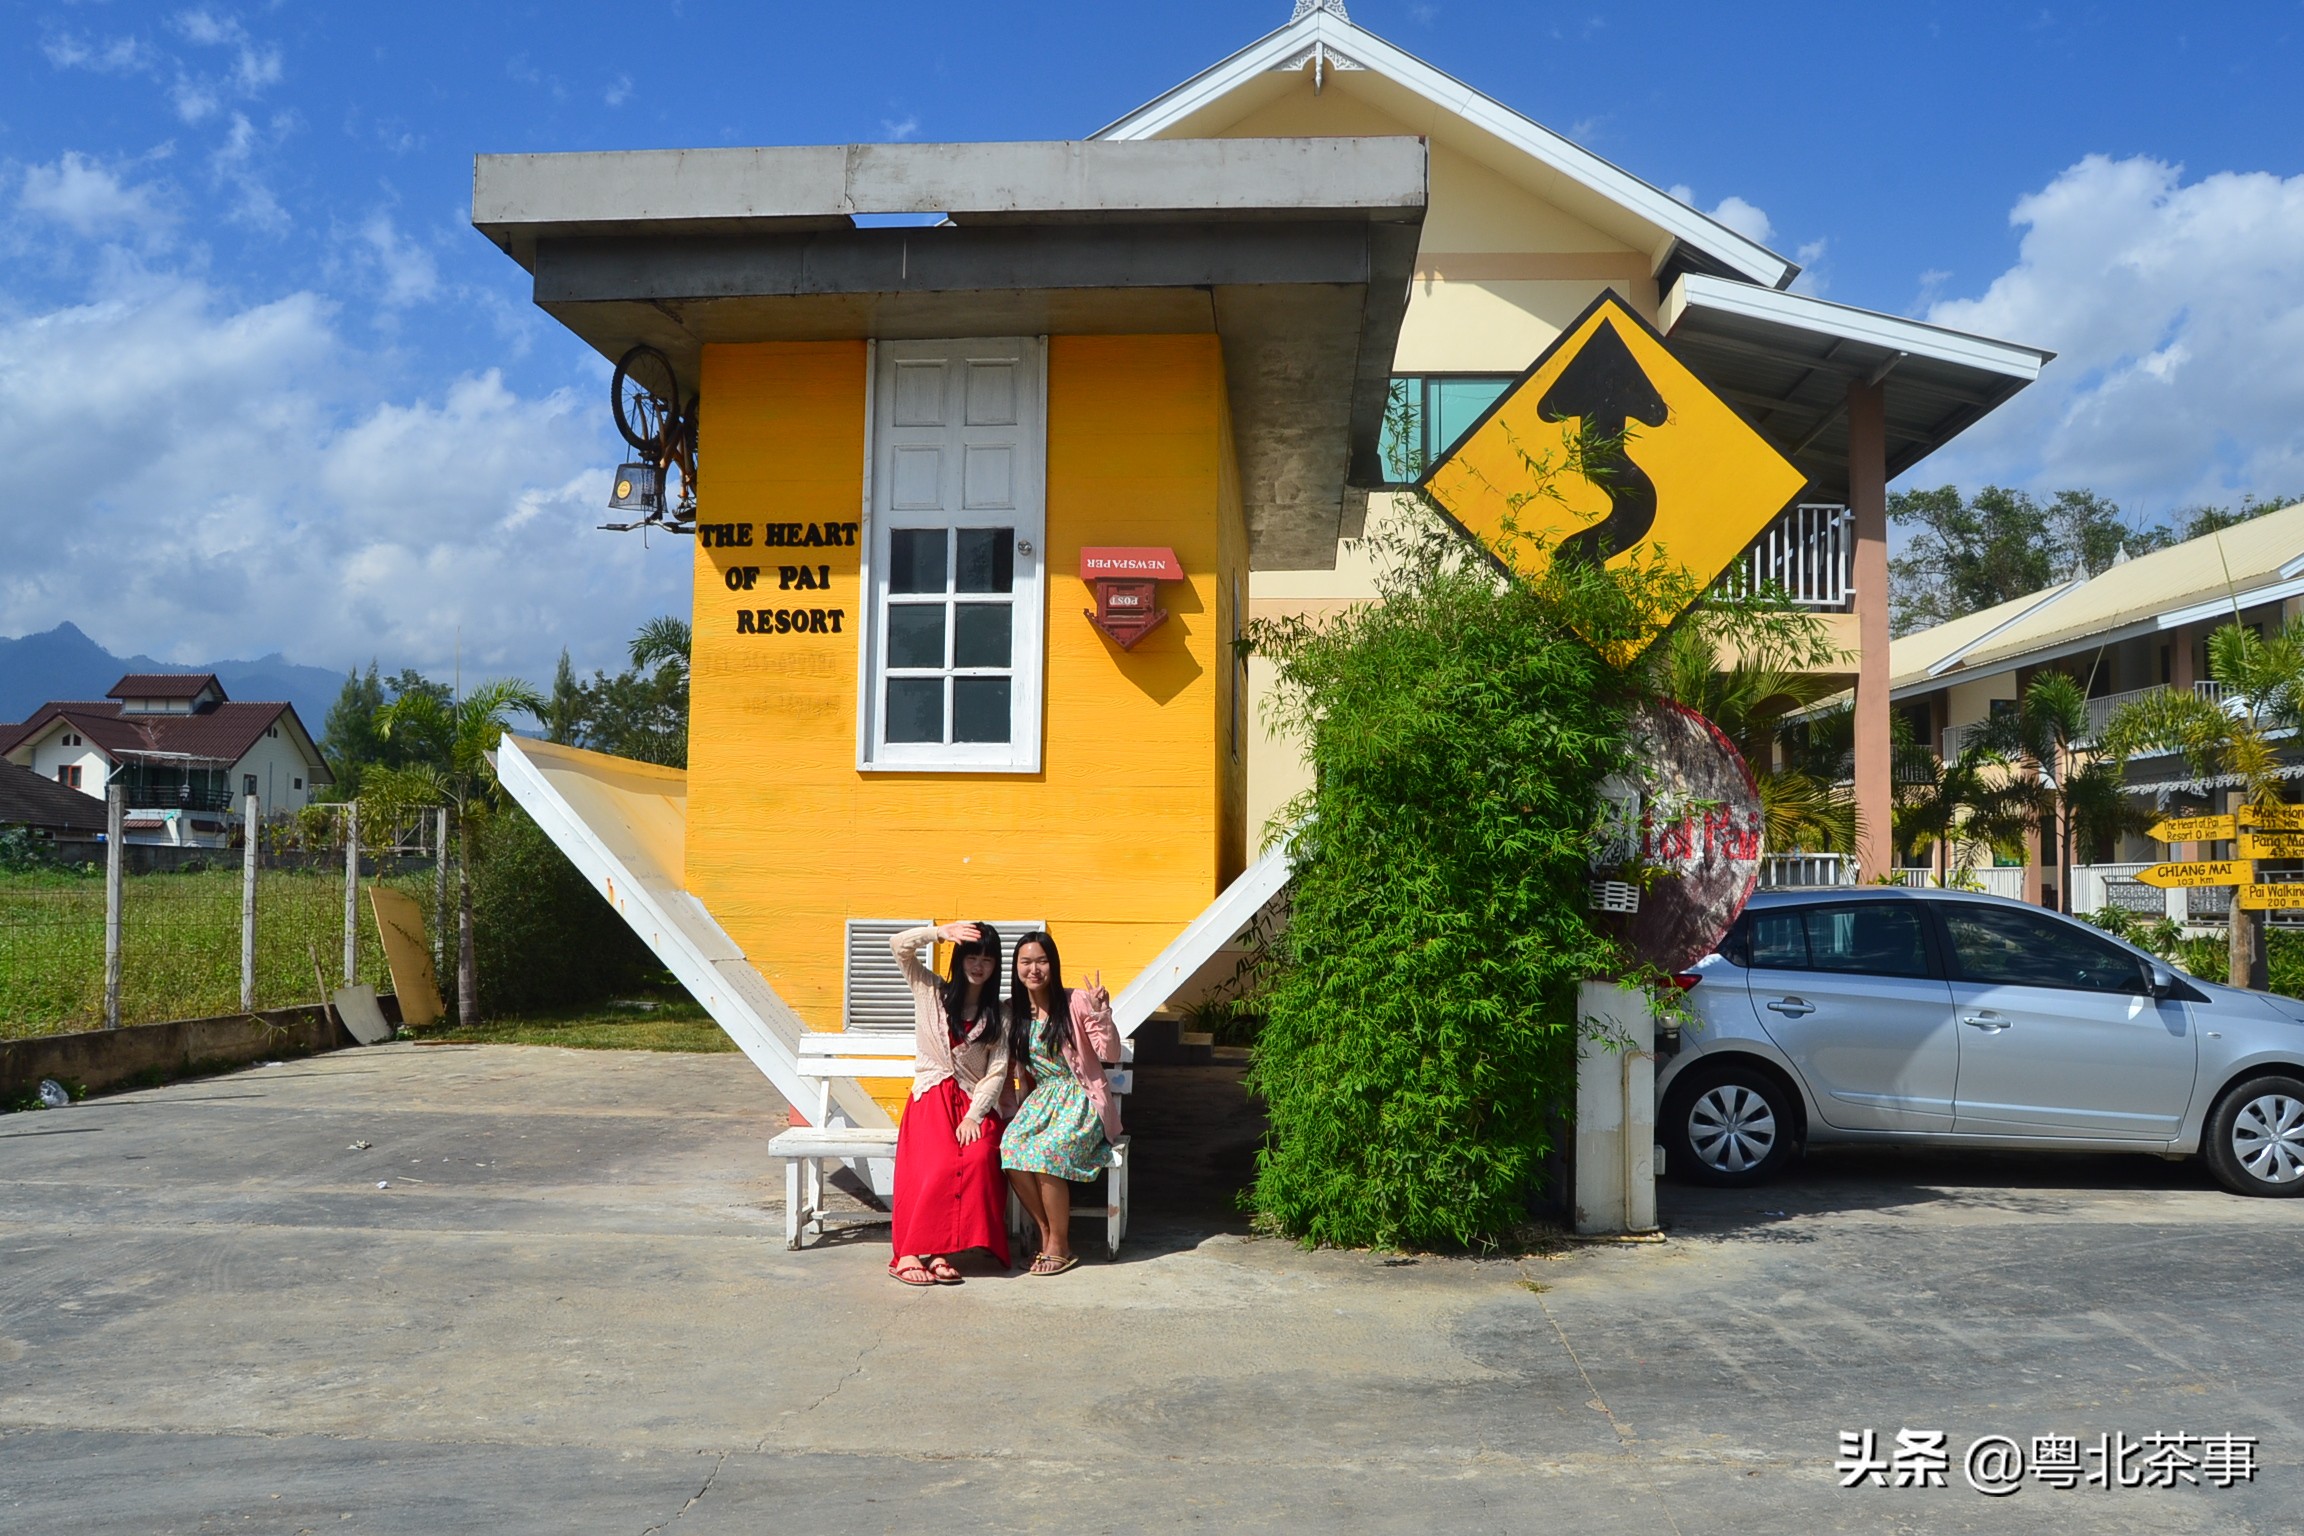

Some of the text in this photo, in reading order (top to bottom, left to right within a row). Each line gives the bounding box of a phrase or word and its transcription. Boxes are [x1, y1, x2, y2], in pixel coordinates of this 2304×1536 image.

[698, 522, 859, 547] THE HEART
[1087, 558, 1166, 570] NEWSPAPER
[725, 565, 831, 591] OF PAI
[1109, 595, 1139, 606] POST
[736, 609, 845, 634] RESORT
[2163, 820, 2176, 830] The
[2178, 819, 2198, 829] Heart
[2207, 817, 2219, 829] Pai
[2167, 830, 2217, 841] Resort 0 km
[2252, 835, 2281, 849] Pang
[2270, 848, 2286, 857] 45
[2157, 863, 2232, 877] CHIANG MAI
[2177, 876, 2214, 886] 103 km
[2249, 885, 2265, 898] Pai
[2268, 898, 2286, 907] 200
